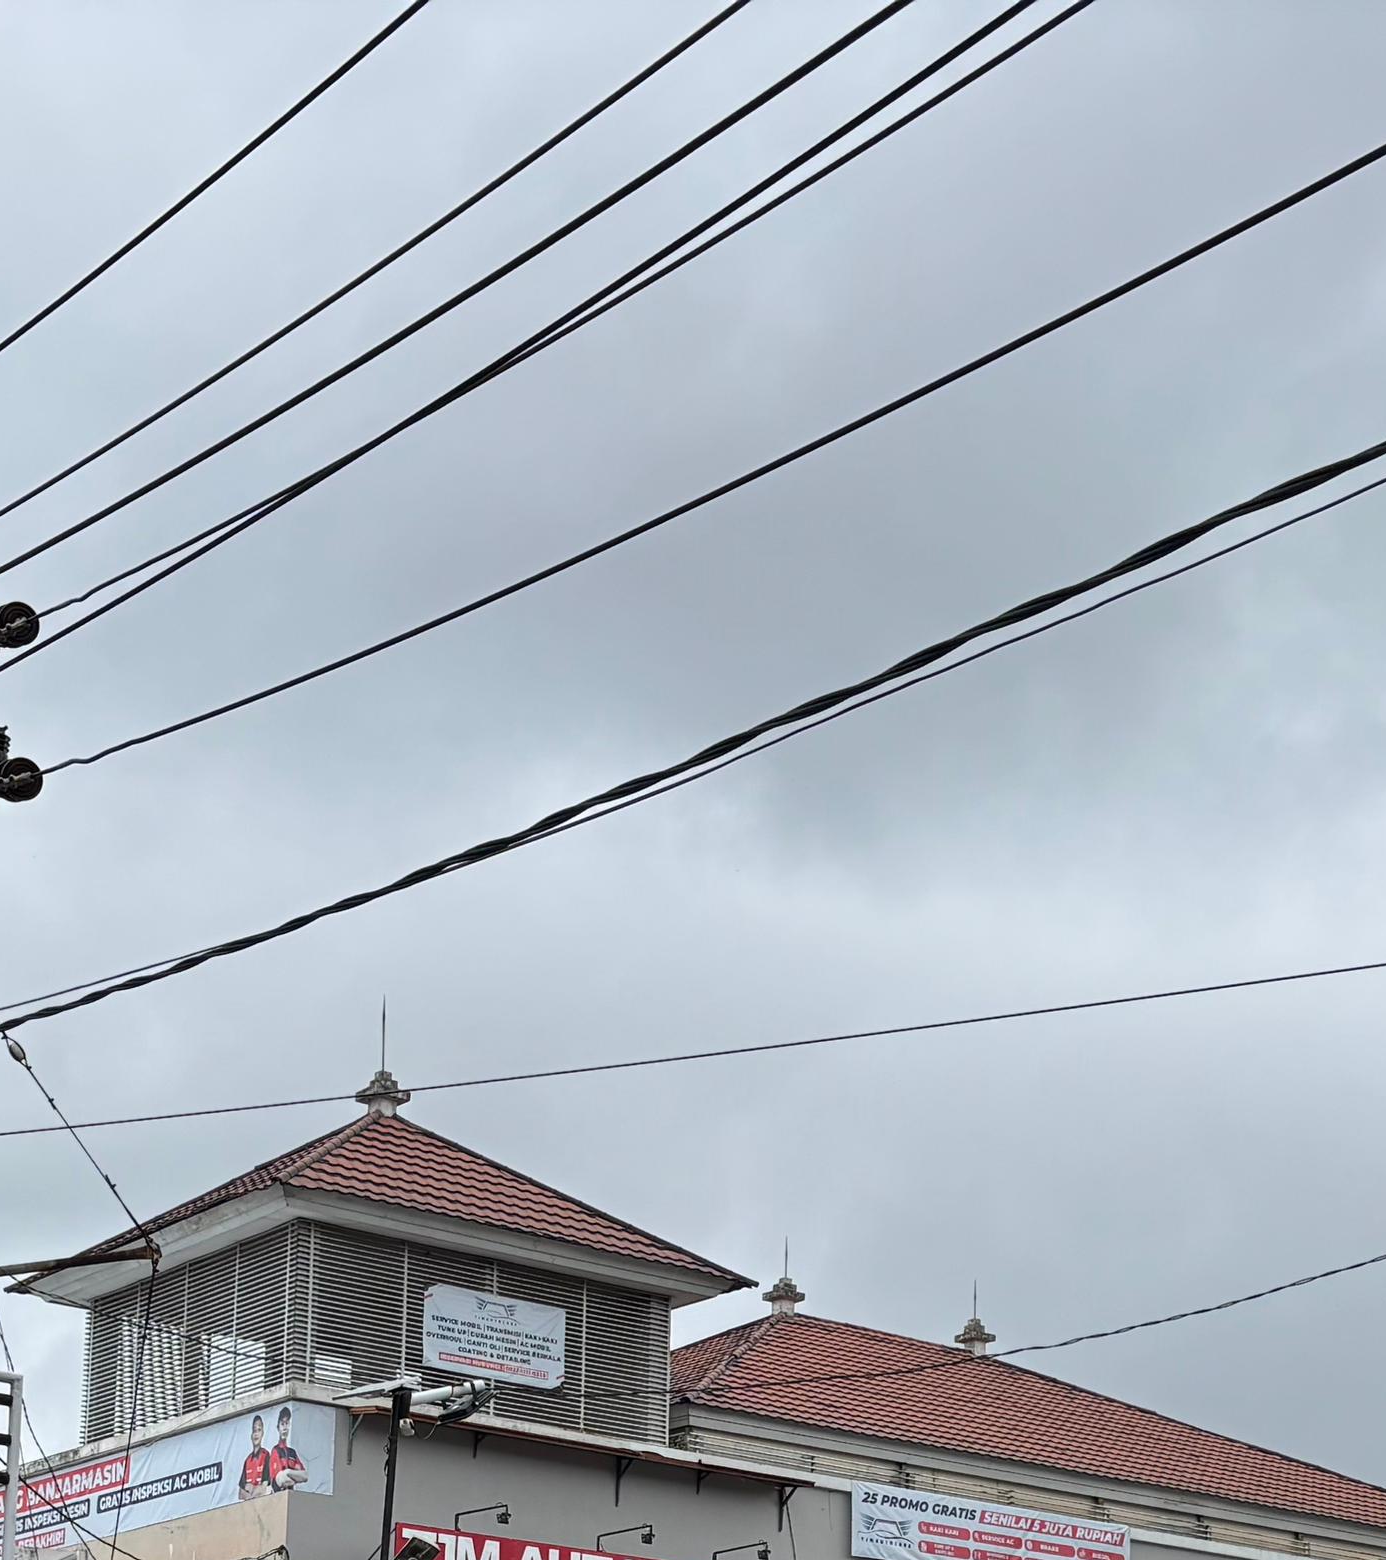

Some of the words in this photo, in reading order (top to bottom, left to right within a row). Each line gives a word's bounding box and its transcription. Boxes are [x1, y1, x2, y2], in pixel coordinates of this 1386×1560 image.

[26, 1458, 128, 1506] BANJARMASIN
[173, 1475, 188, 1490] AC
[188, 1466, 220, 1487] MOBIL
[861, 1491, 879, 1505] 25
[880, 1494, 930, 1513] PROMO
[932, 1503, 977, 1521] GRATIS
[983, 1511, 1031, 1530] SENILAI
[1032, 1521, 1042, 1533] 5
[1042, 1523, 1073, 1538] JUTA
[1075, 1527, 1122, 1546] RUPIAH
